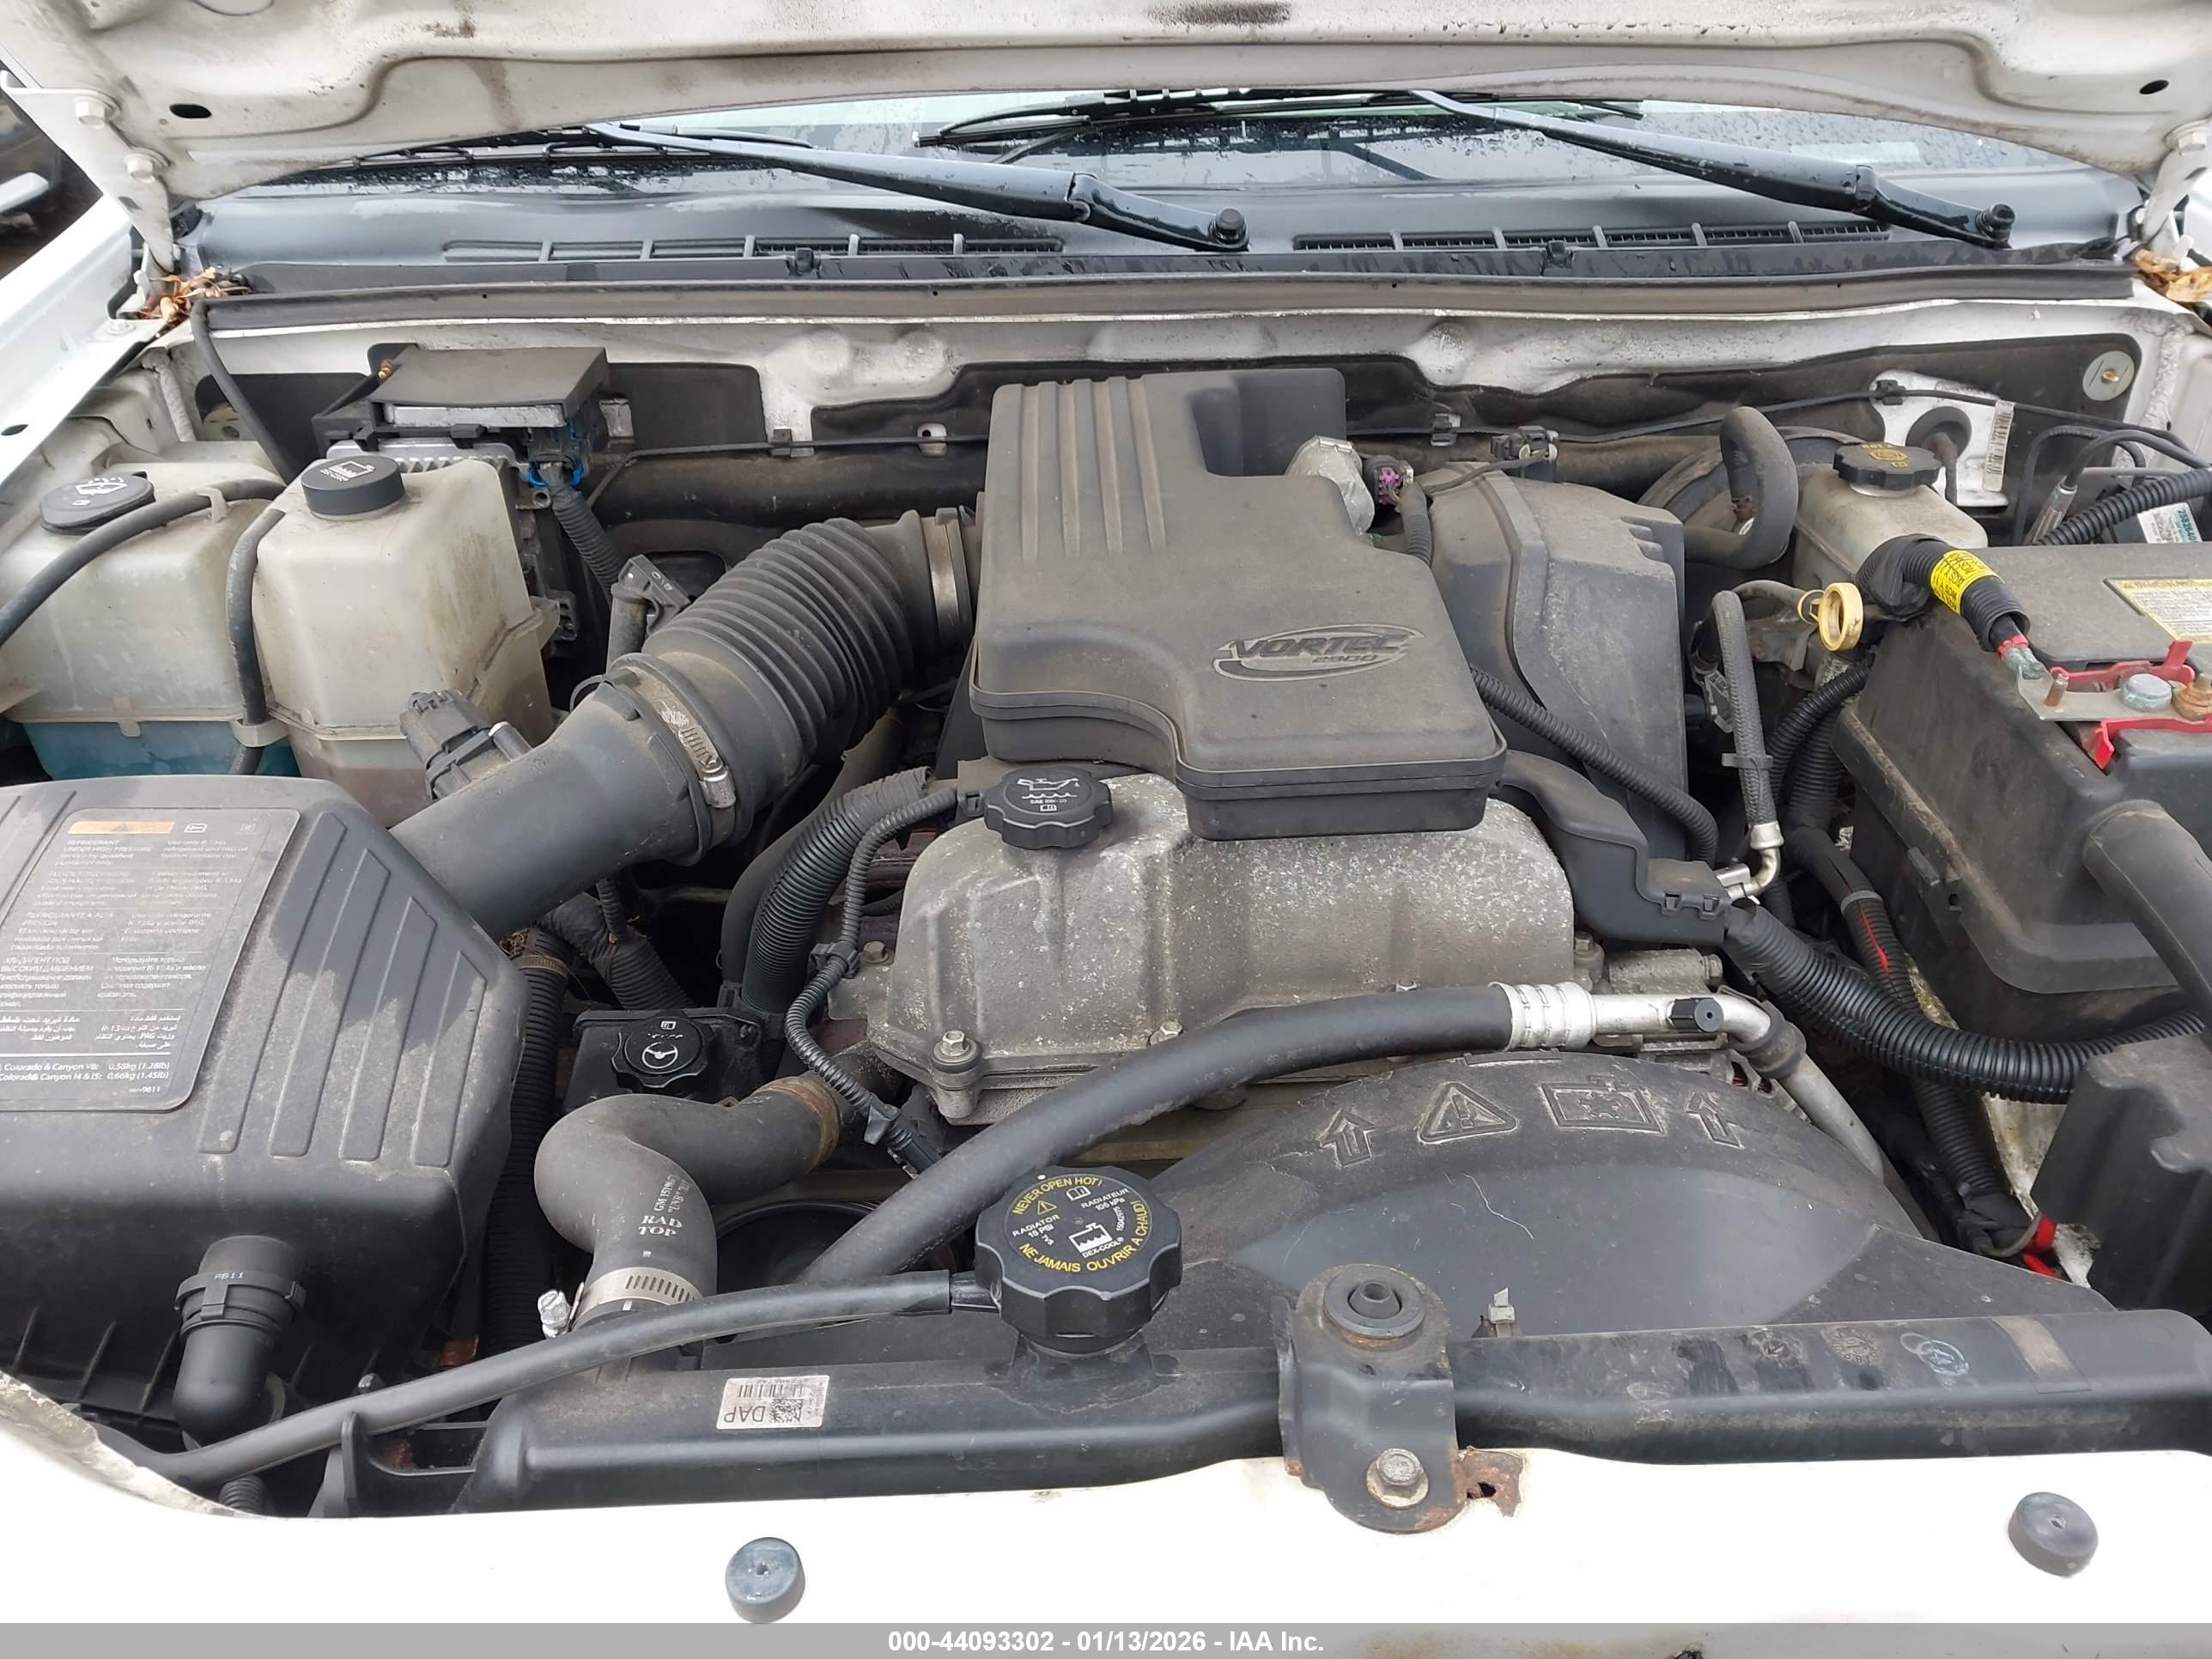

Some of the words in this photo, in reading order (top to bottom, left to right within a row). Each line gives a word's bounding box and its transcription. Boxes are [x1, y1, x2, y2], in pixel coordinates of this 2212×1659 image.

[1236, 634, 1408, 658] VORTEC
[3, 1063, 43, 1072] Colorado
[52, 1063, 85, 1073] Canyon
[108, 1062, 137, 1072] 0.58kg
[40, 1073, 72, 1083] Canyon
[106, 1072, 136, 1081] 0.66kg
[137, 1071, 169, 1079] (1.45lb)
[1012, 1188, 1044, 1215] NEVER
[1040, 1177, 1073, 1192] OPEN
[1074, 1176, 1103, 1187] HOT!
[1080, 1188, 1130, 1209] RADIATEUR
[1095, 1202, 1110, 1211] 105
[1109, 1197, 1126, 1206] kPa
[641, 1215, 683, 1228] RAD
[1012, 1214, 1060, 1237] RADIATOR
[638, 1225, 678, 1237] TOP
[1027, 1230, 1040, 1238] 15
[1038, 1224, 1054, 1235] PSI
[1018, 1242, 1037, 1258] NE
[1034, 1253, 1082, 1272] JAMAIS
[1085, 1244, 1138, 1271] OUVRIR
[723, 1406, 766, 1423] DAP
